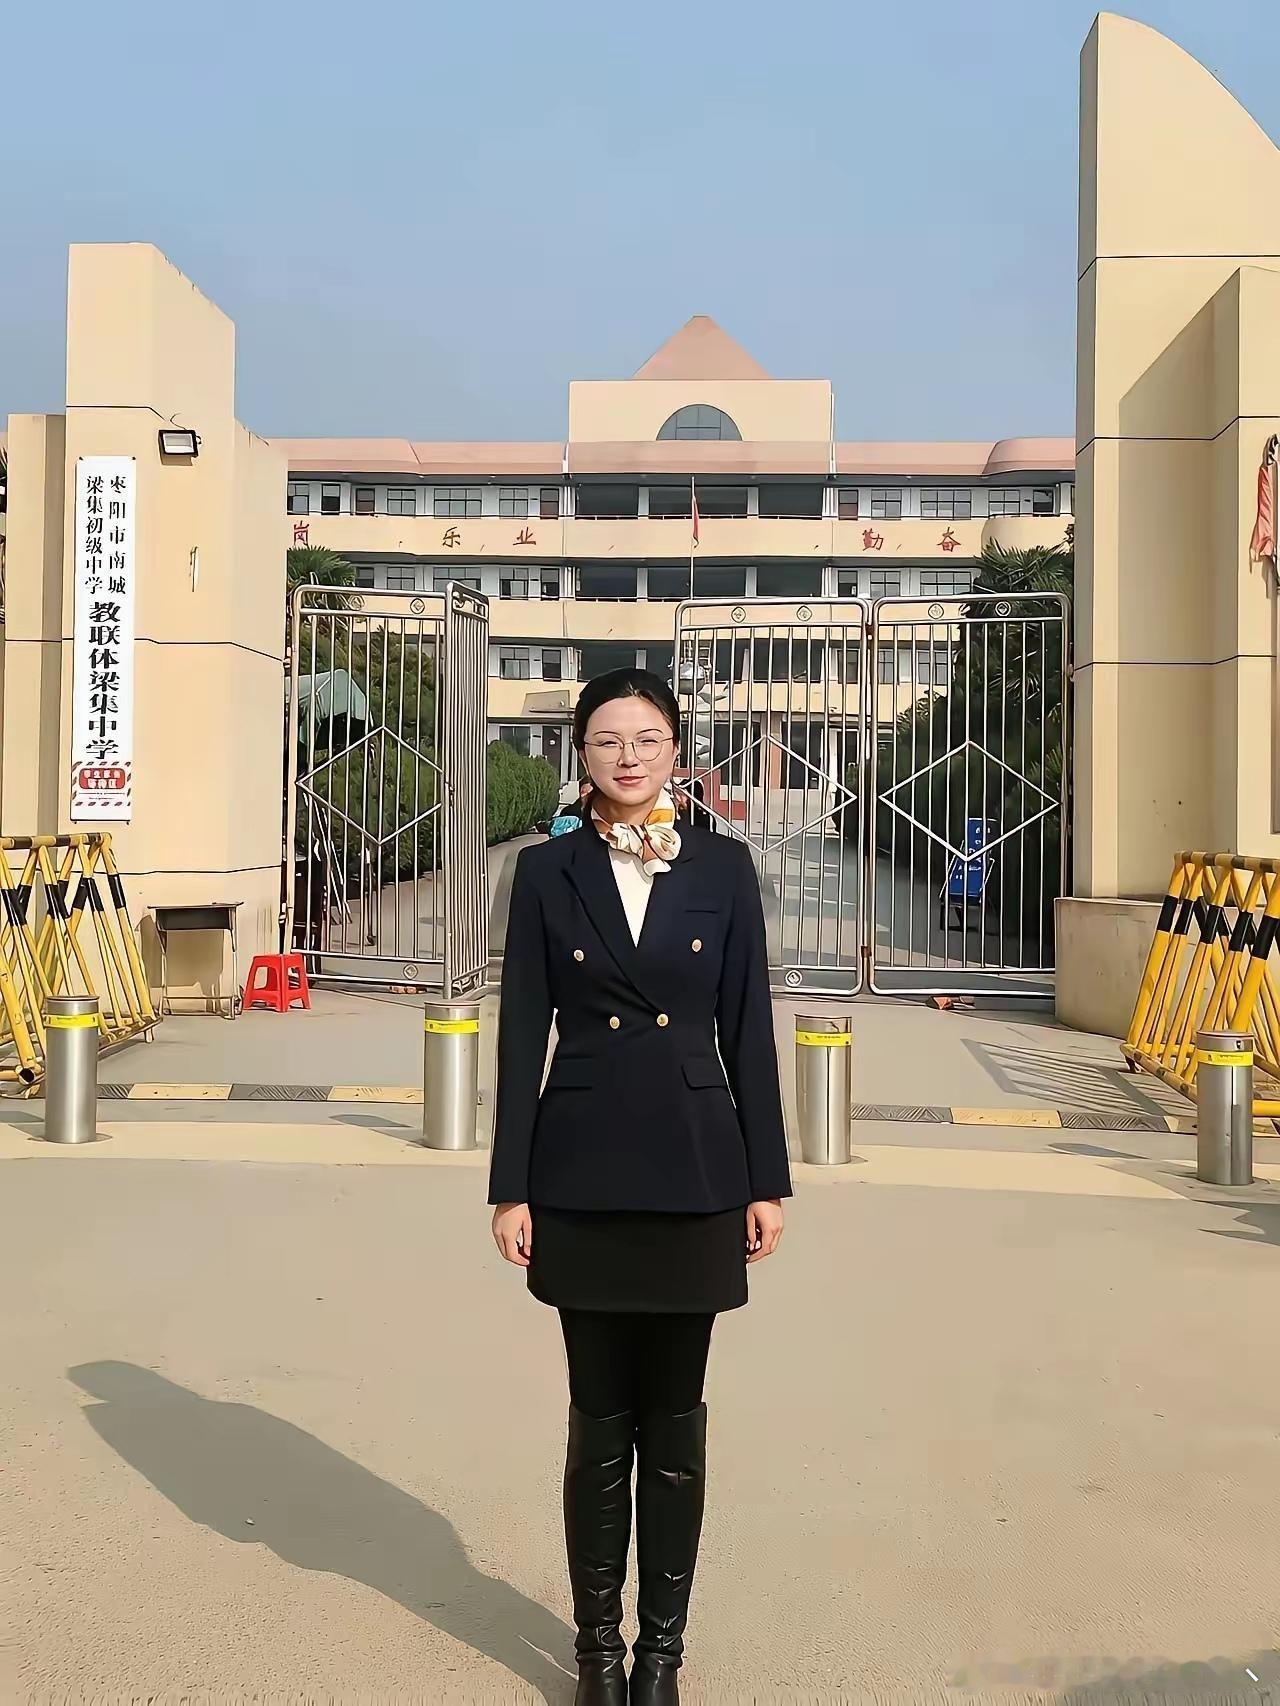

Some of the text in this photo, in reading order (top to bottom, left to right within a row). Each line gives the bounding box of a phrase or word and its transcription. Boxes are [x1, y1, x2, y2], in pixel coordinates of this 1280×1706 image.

[85, 475, 104, 594] 梁集初级中学
[110, 476, 126, 594] 枣阳市南城
[86, 602, 121, 759] 教联体梁集中学
